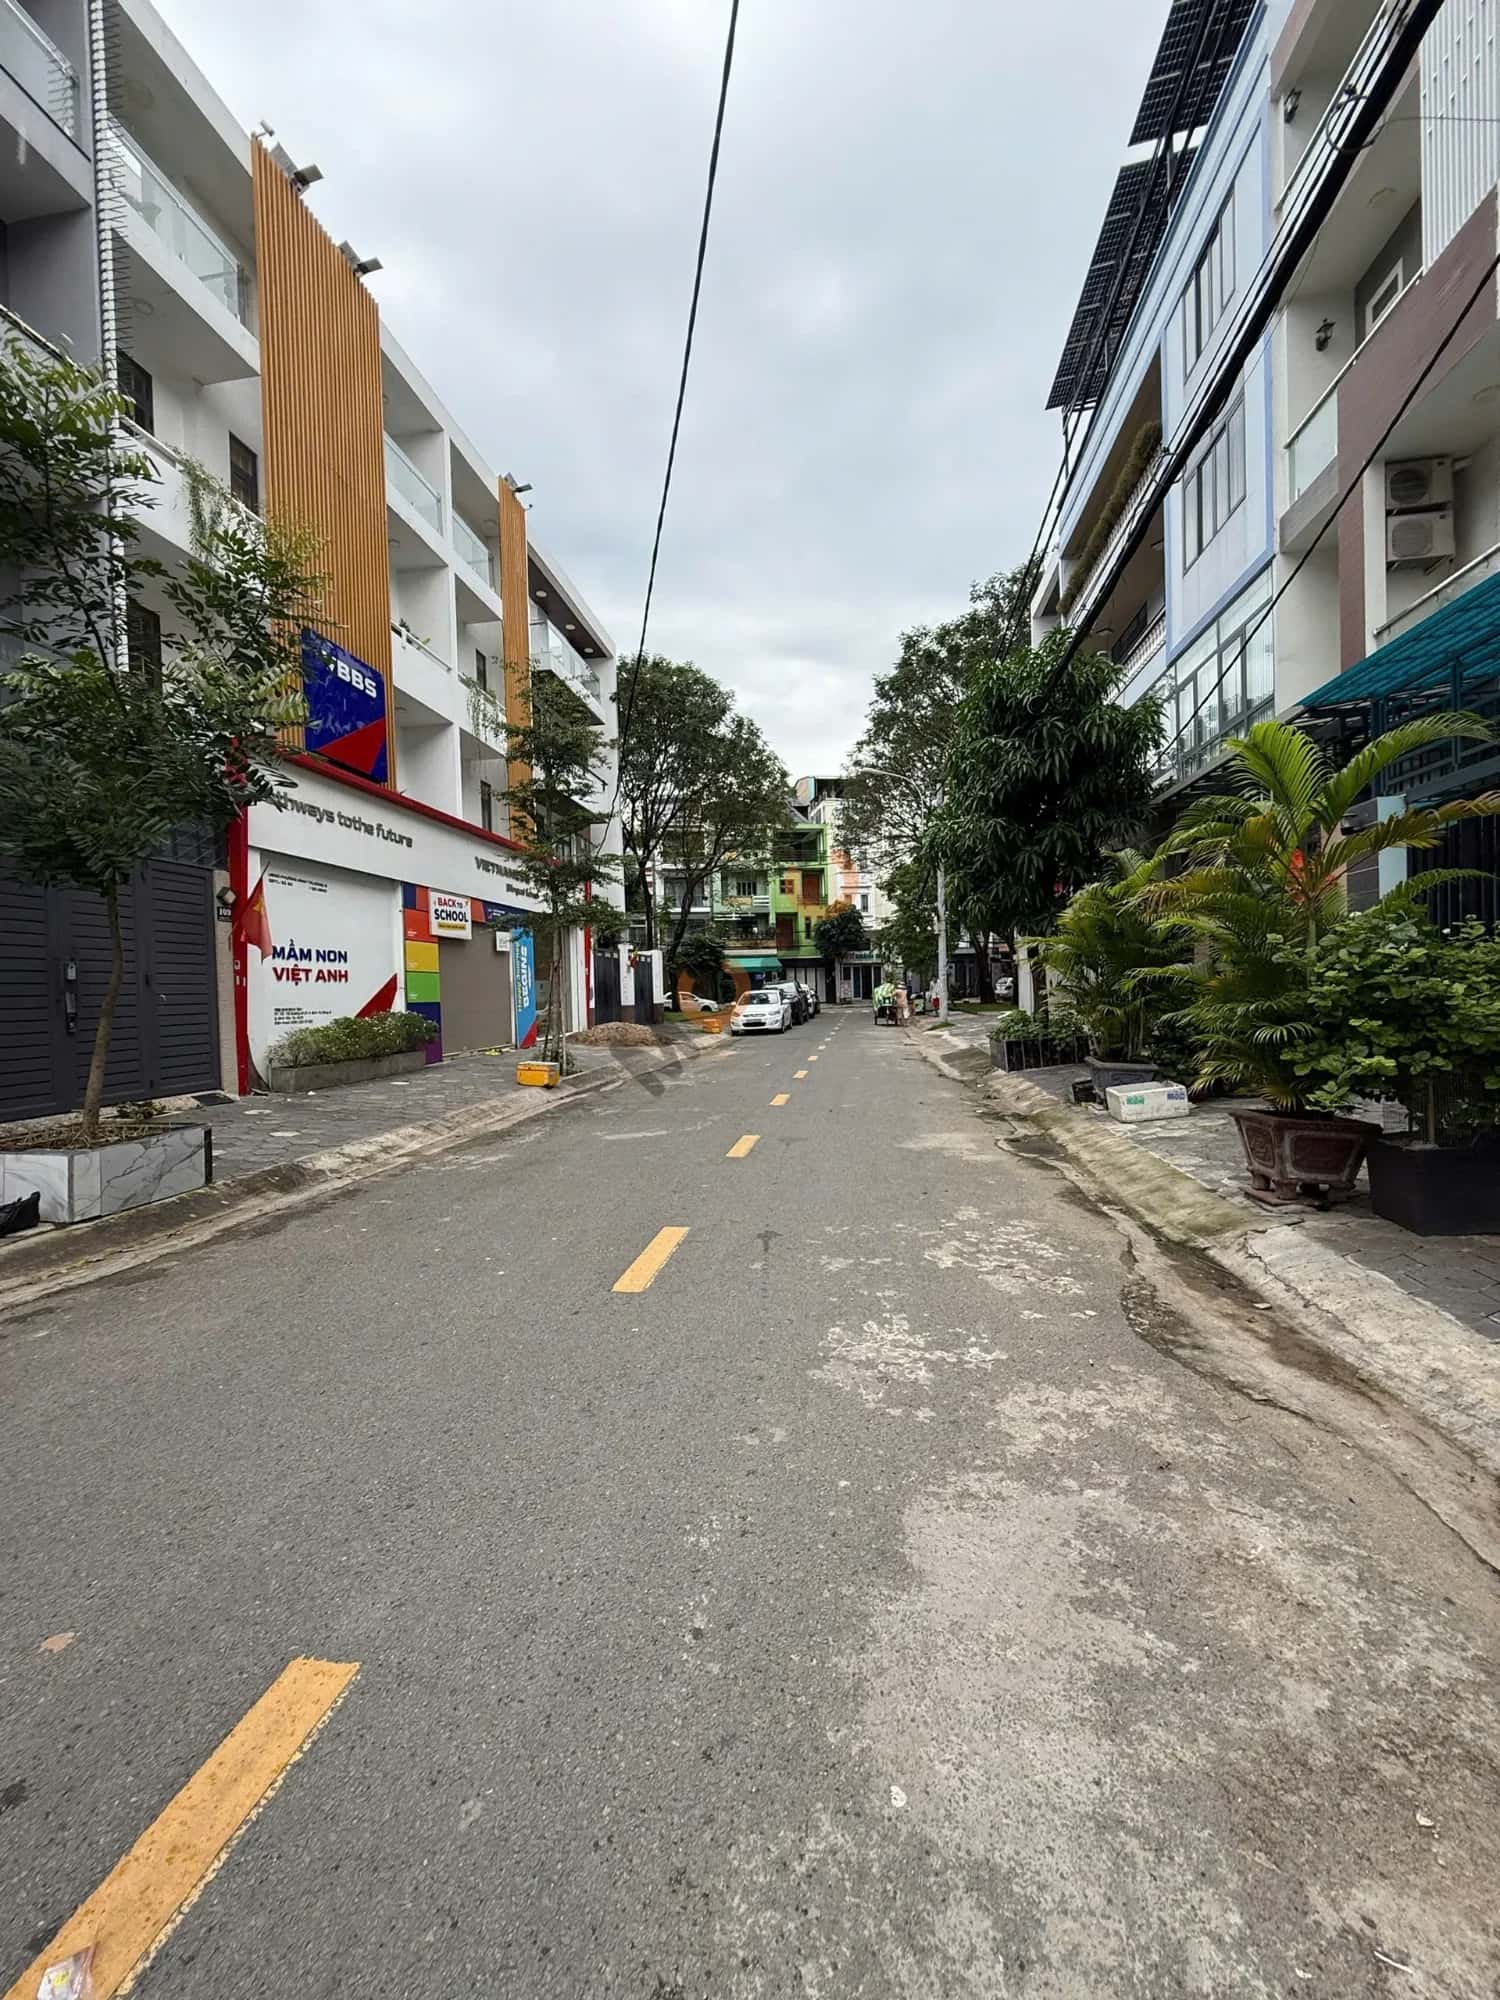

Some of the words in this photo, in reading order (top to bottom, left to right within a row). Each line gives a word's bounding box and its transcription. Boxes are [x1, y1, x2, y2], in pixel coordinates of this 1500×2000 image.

[376, 823, 413, 848] future
[438, 897, 456, 908] BACK
[434, 908, 469, 922] SCHOOL
[316, 949, 348, 963] NON
[272, 963, 312, 986] VIỆT
[315, 969, 348, 983] ANH
